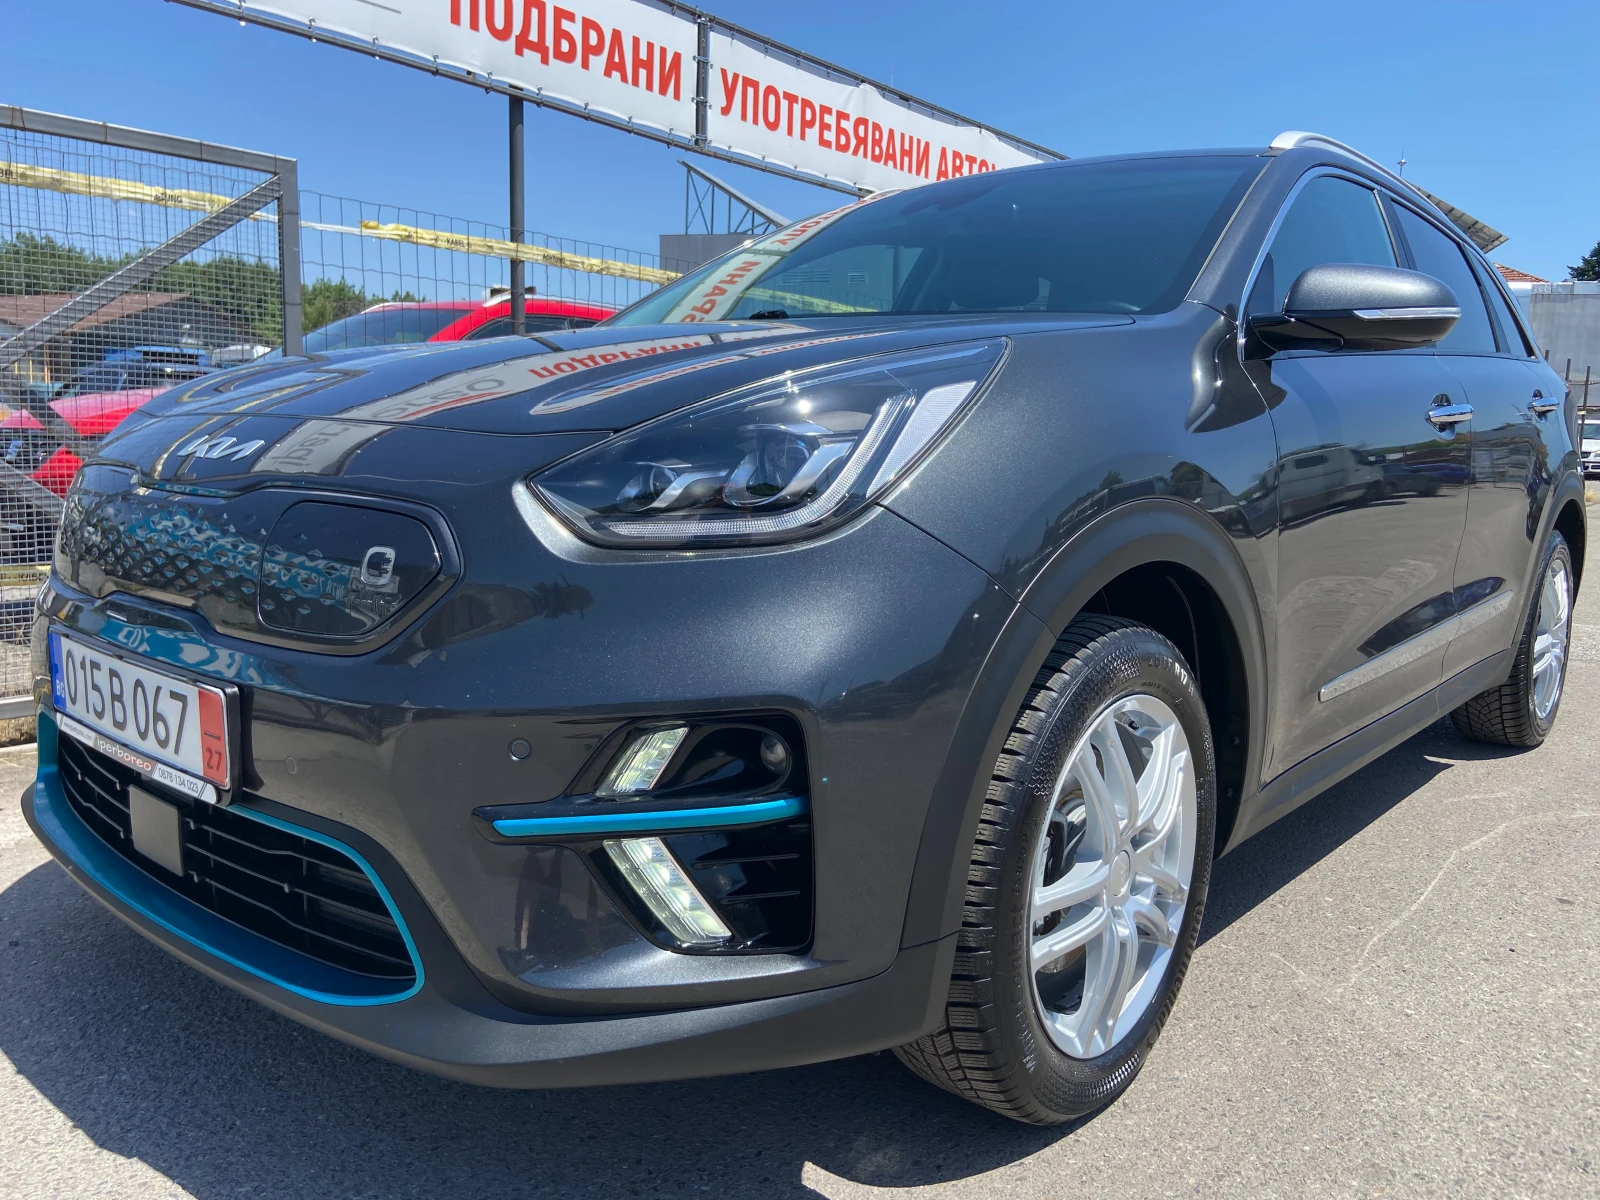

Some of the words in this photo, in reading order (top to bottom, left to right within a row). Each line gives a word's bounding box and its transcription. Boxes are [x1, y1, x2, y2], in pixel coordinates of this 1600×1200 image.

[720, 67, 930, 180] УПОТРЕБЯВАНИ
[936, 146, 997, 182] АВТ
[177, 434, 265, 462] KIA
[56, 680, 65, 698] BG
[65, 648, 189, 756] 015B067
[205, 746, 223, 772] 27
[158, 766, 174, 783] 0878
[174, 774, 186, 788] 134
[187, 780, 199, 794] 023
